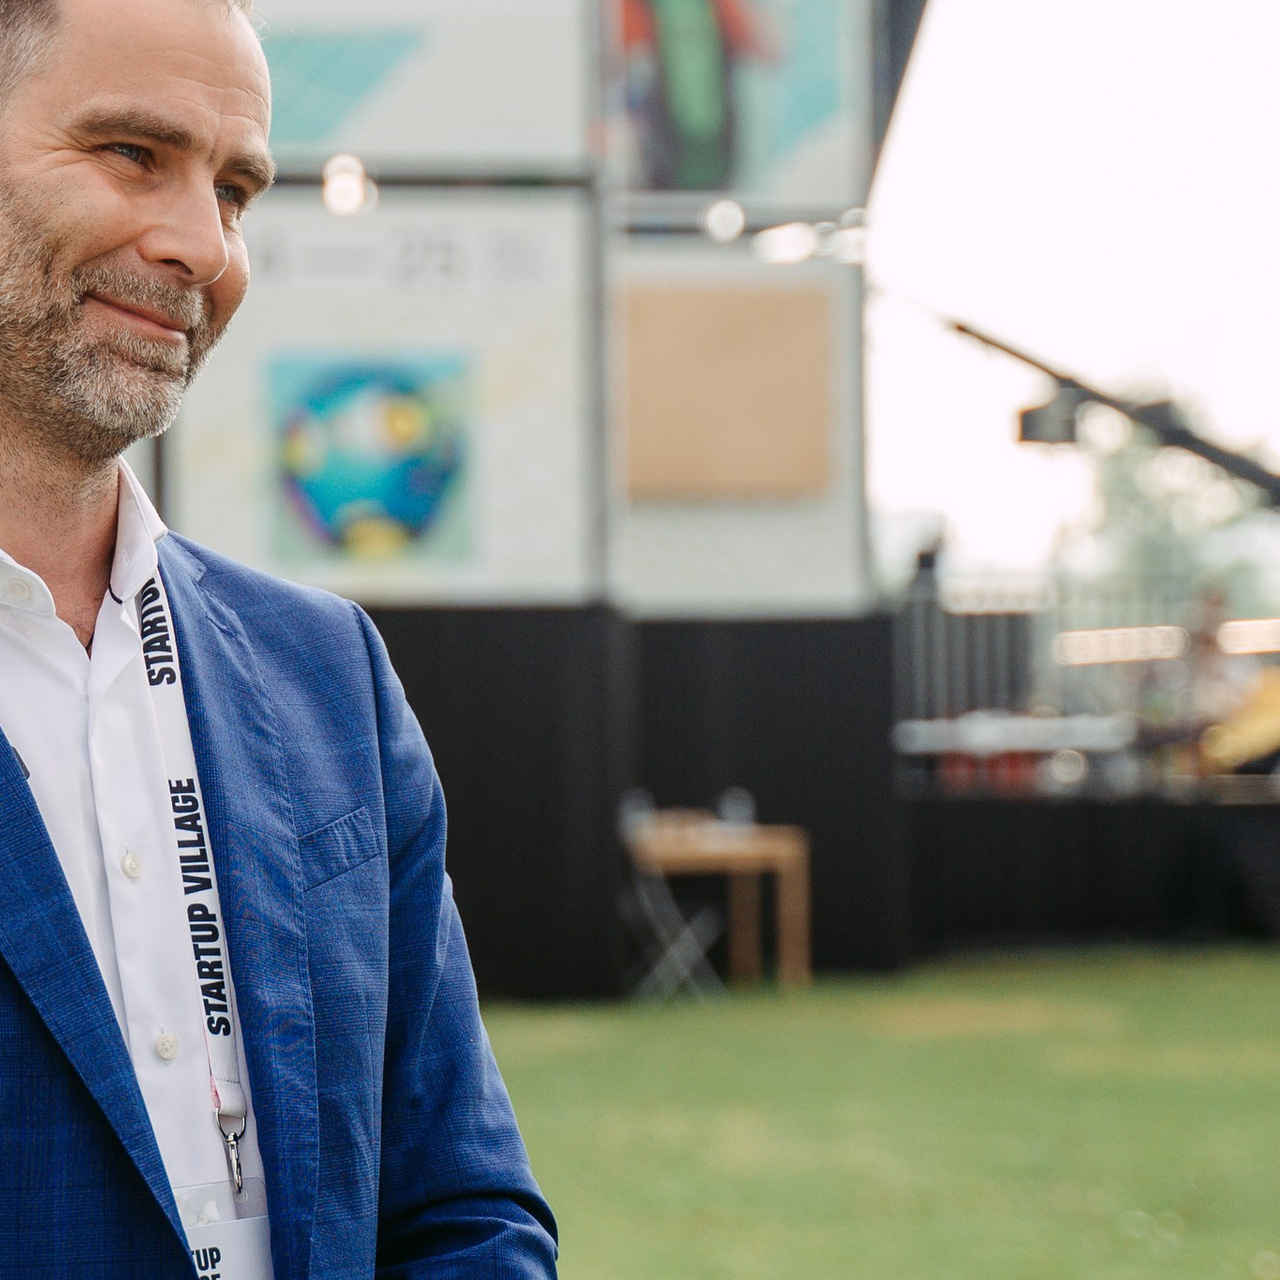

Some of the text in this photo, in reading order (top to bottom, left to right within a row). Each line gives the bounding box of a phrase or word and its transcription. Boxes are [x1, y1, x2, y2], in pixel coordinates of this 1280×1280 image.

[168, 778, 231, 1037] STARTUP VILLAGE
[191, 1247, 221, 1271] UP
